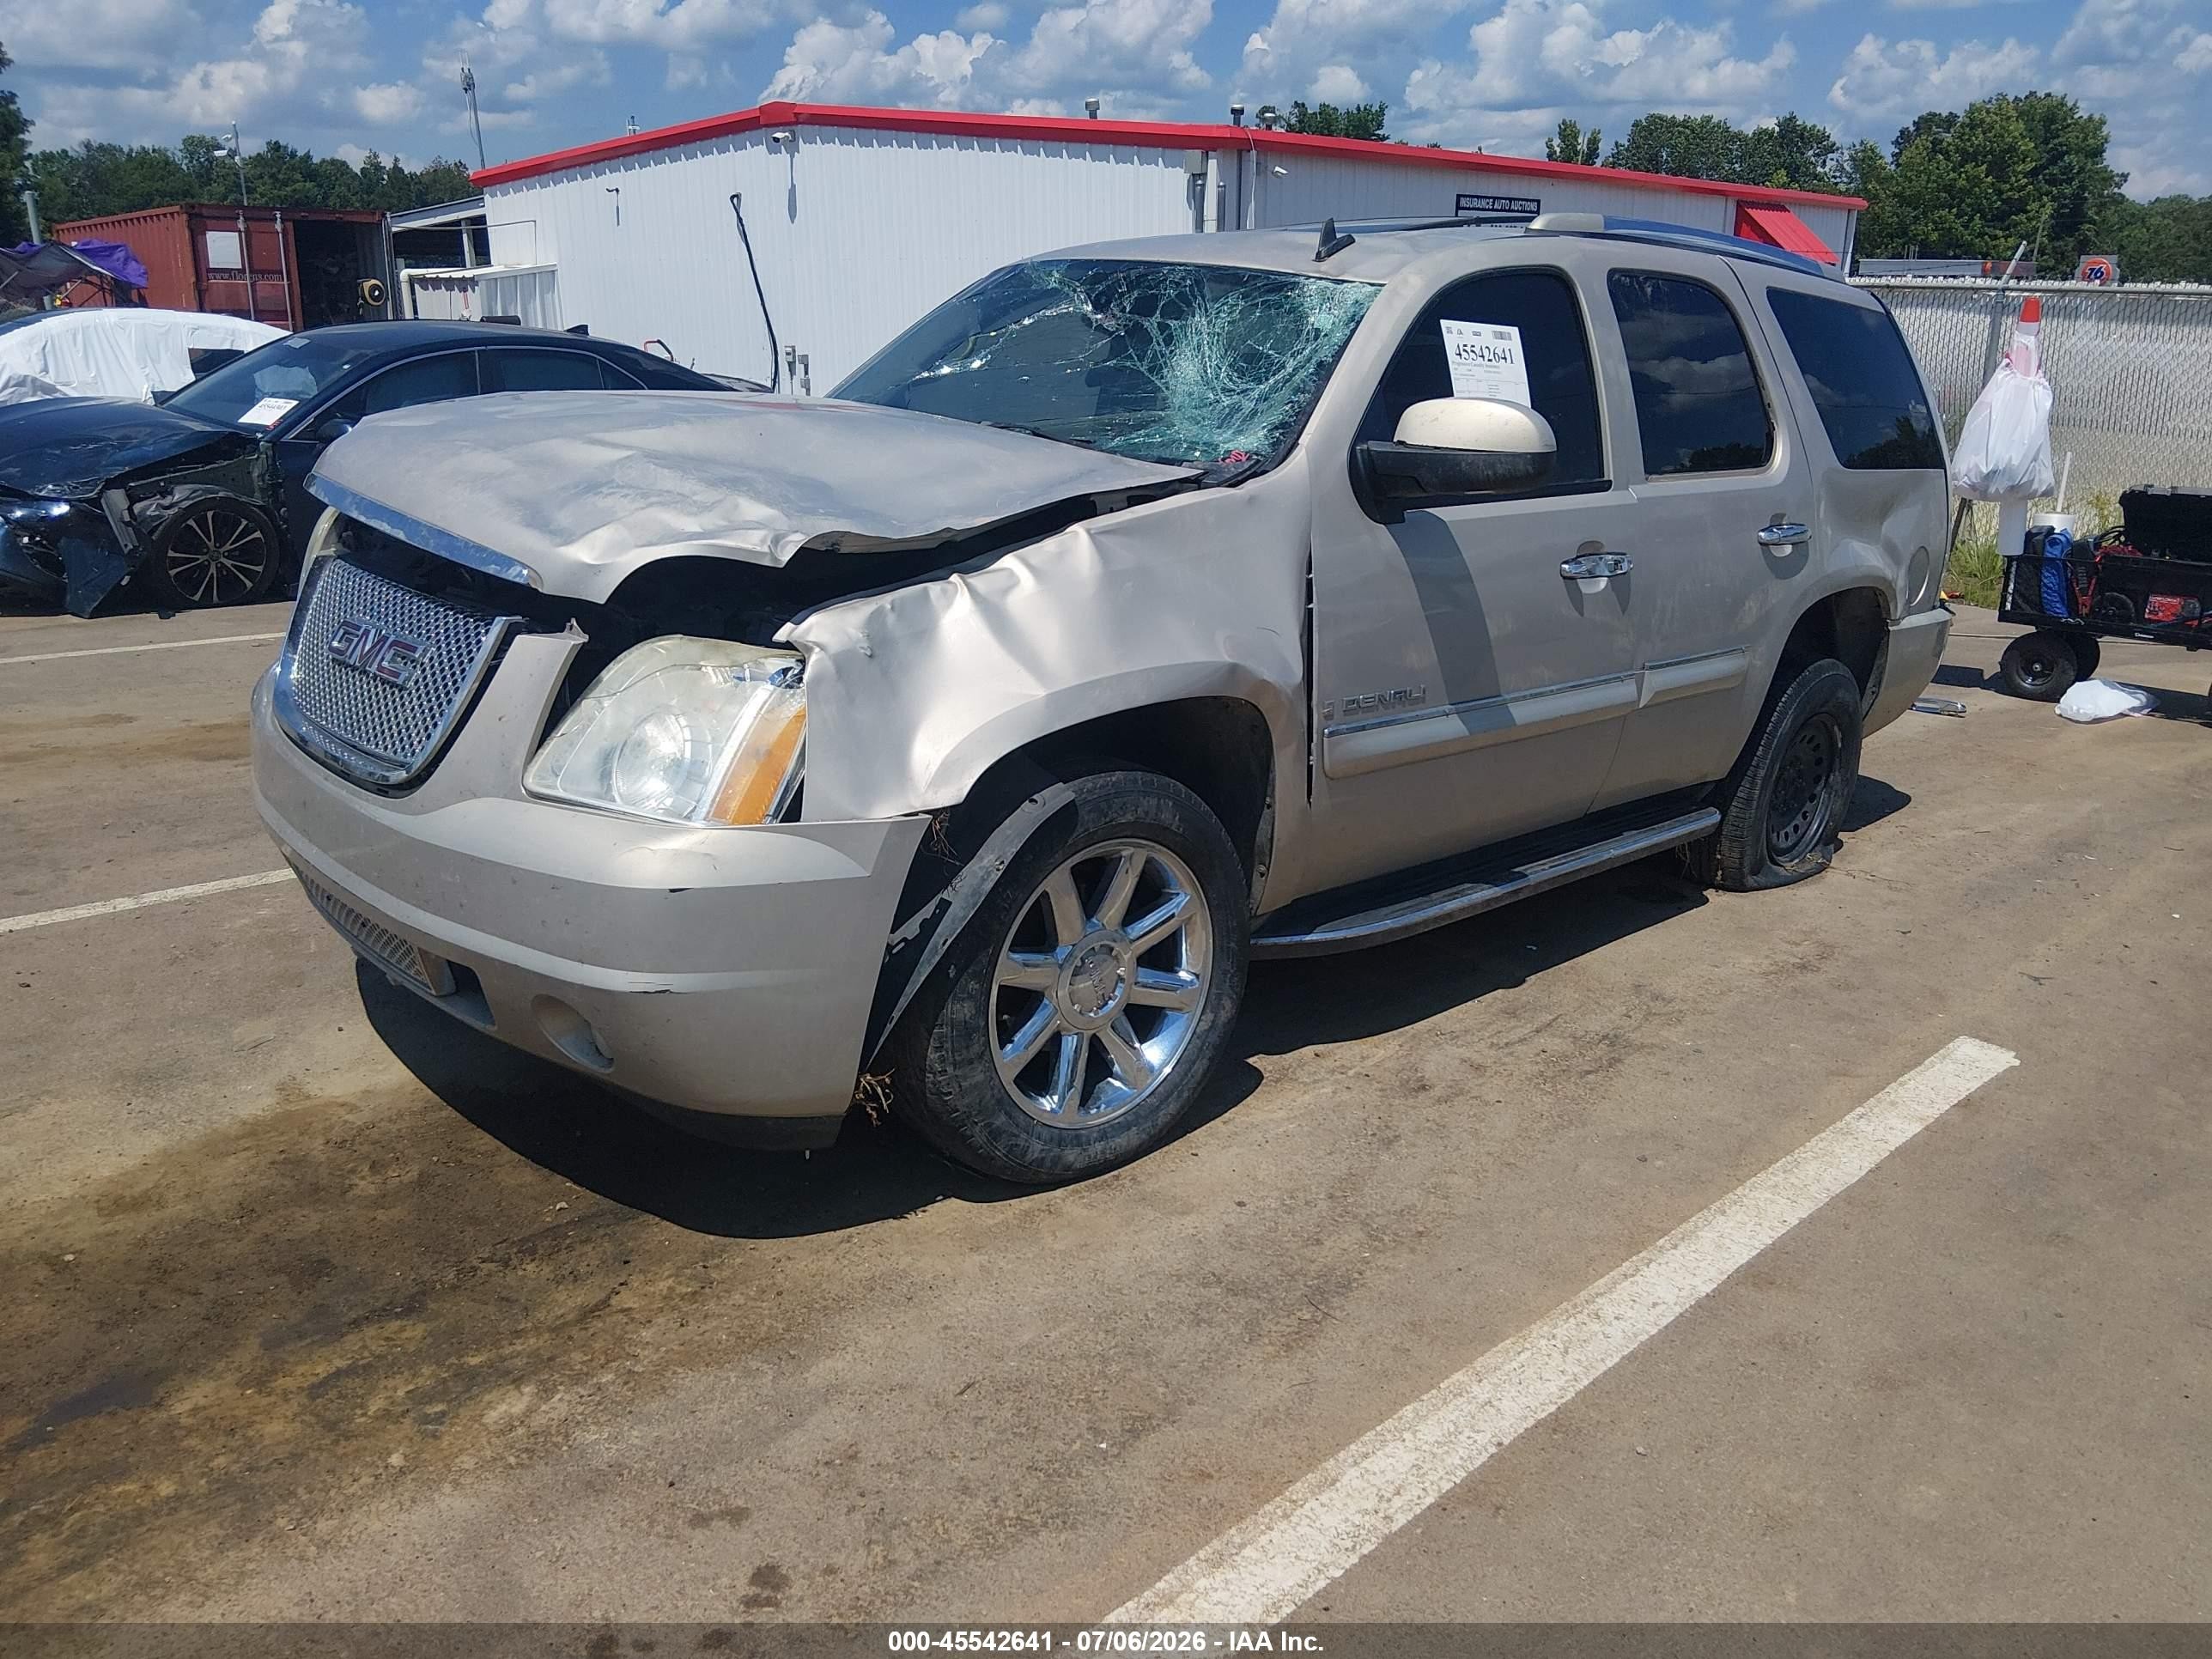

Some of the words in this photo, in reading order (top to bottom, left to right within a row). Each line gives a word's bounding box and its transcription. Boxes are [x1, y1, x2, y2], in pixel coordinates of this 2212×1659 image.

[1459, 197, 1493, 210] INSURANCE
[1494, 199, 1510, 210] AUTO
[1510, 200, 1538, 212] AUCTIONS
[2086, 264, 2106, 280] 76
[1455, 343, 1515, 365] 45542641
[327, 618, 426, 685] GMC
[1342, 684, 1426, 711] DENALI
